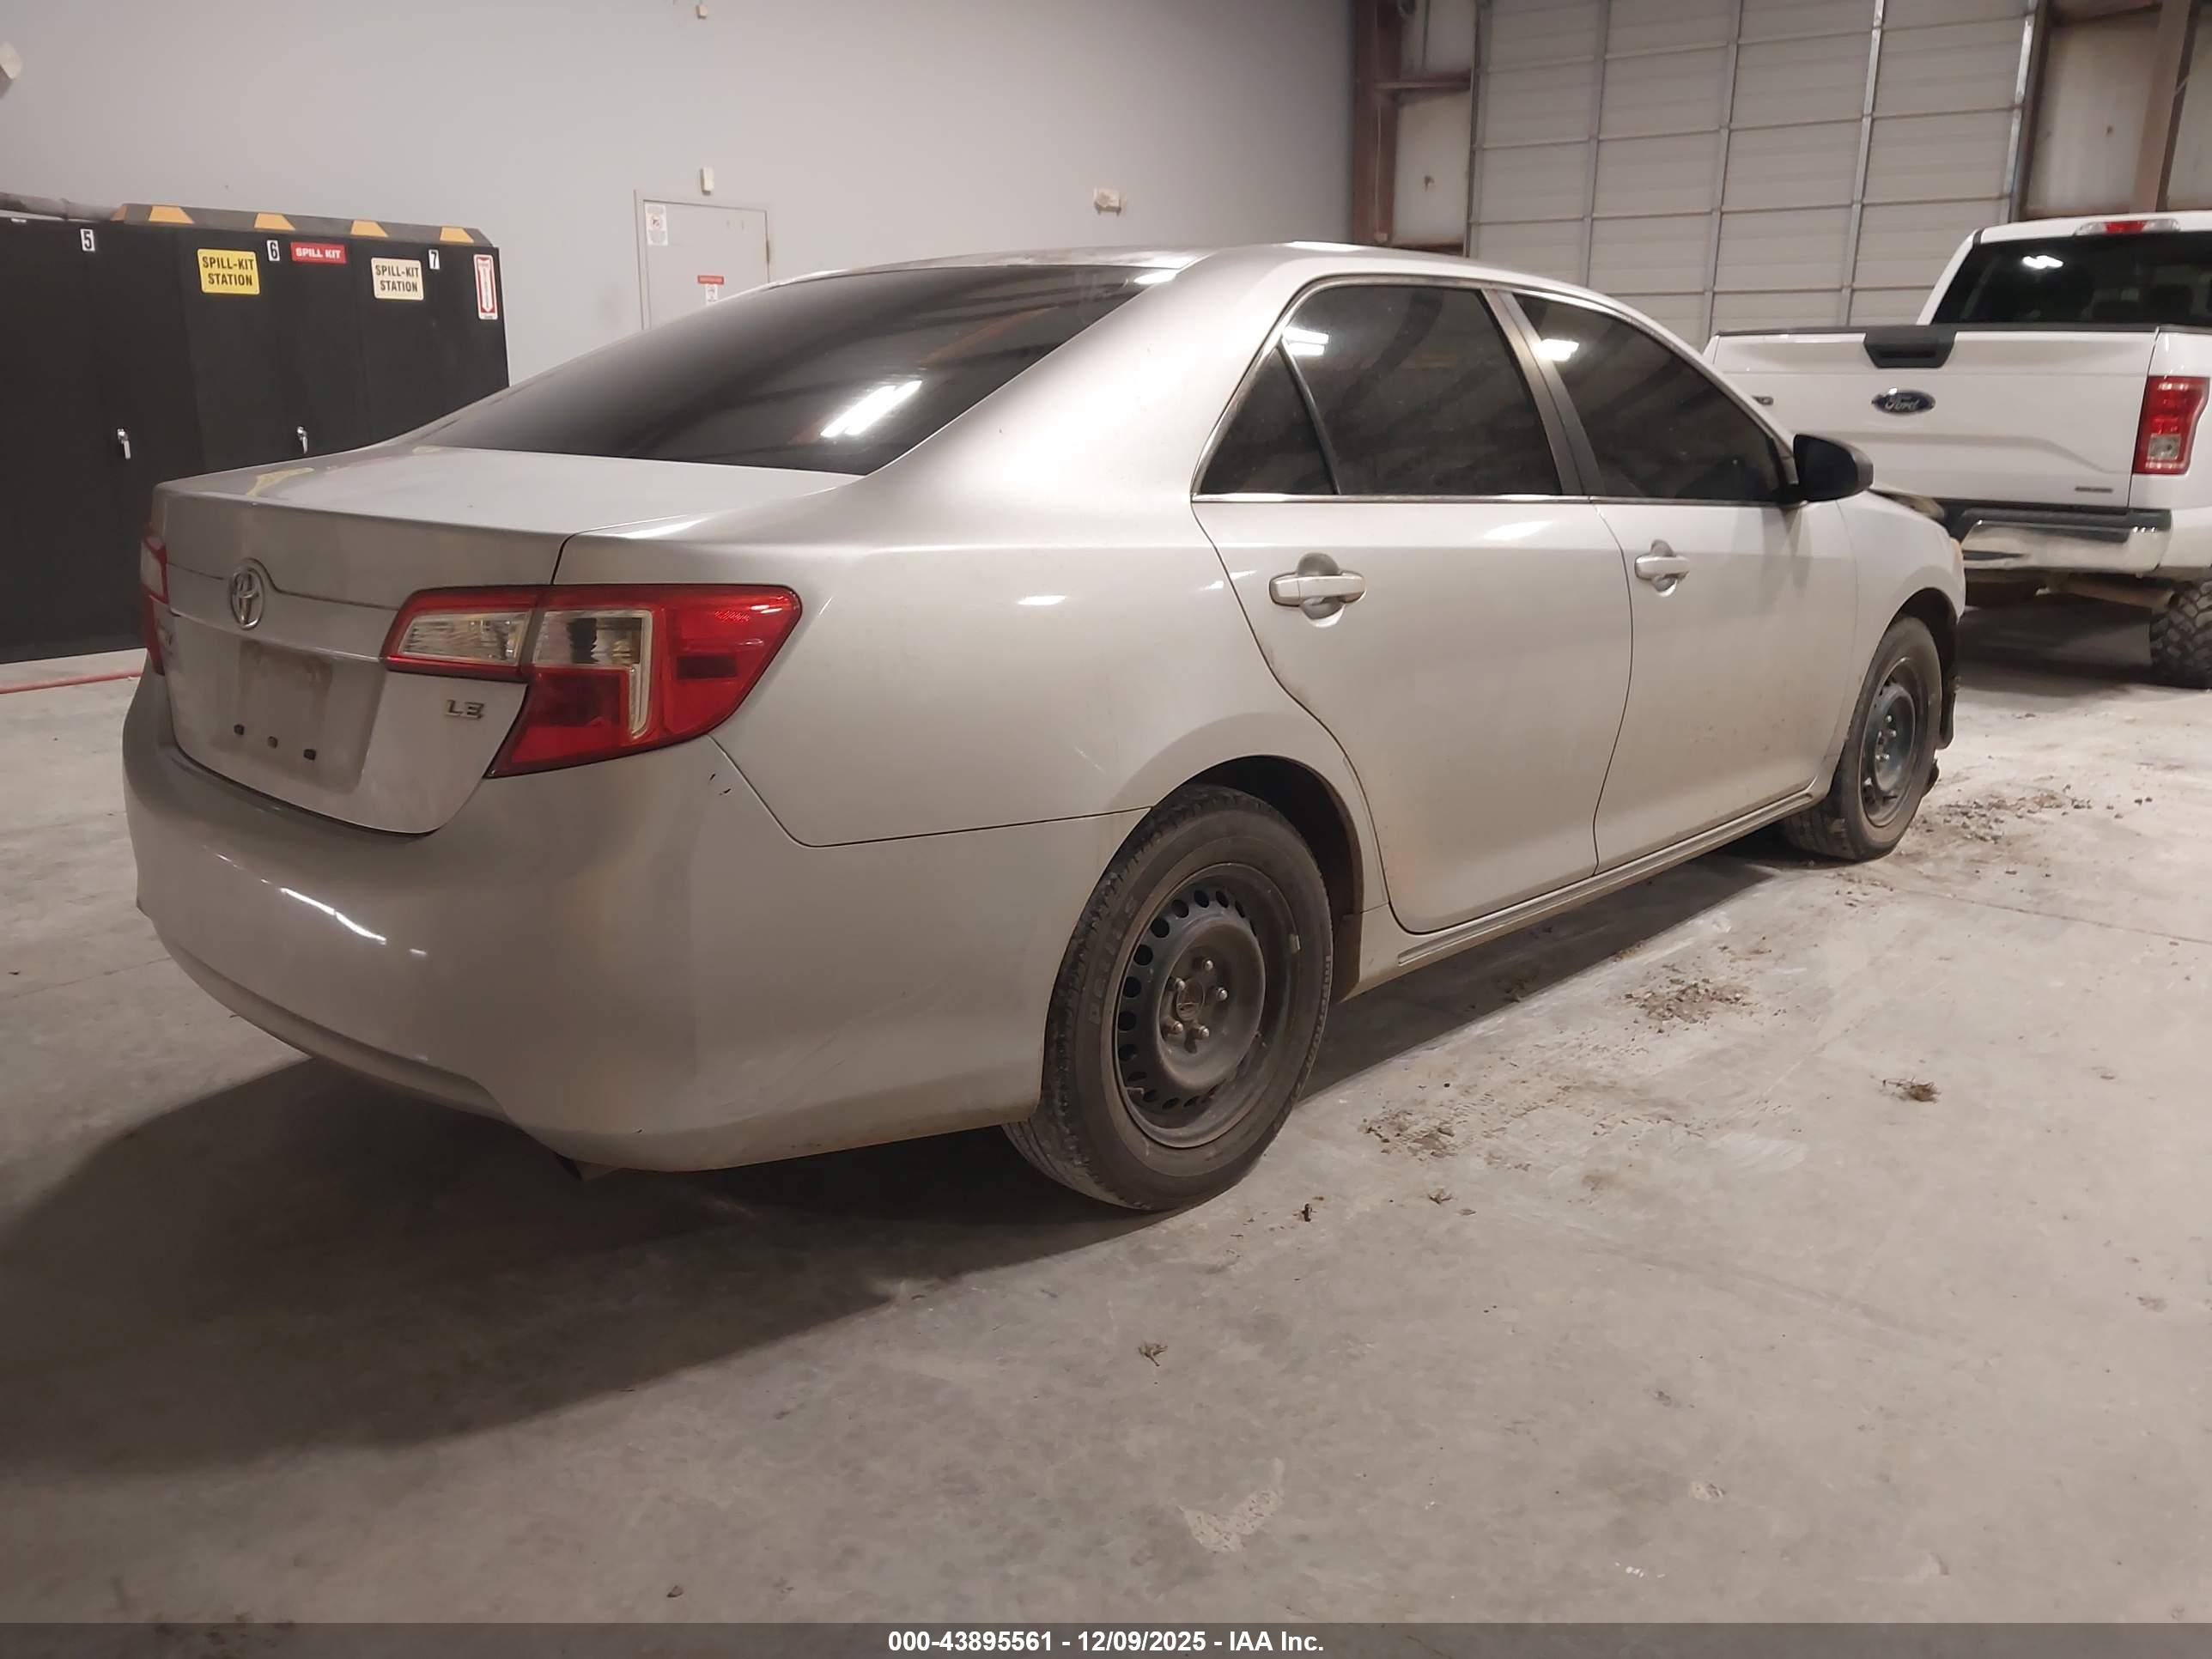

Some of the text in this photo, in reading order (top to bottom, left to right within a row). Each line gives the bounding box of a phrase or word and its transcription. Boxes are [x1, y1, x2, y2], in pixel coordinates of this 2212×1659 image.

[83, 229, 93, 249] 5
[270, 241, 278, 259] 6
[295, 247, 342, 259] SPILL KIT
[202, 256, 254, 270] SPILL-KIT
[430, 251, 437, 269] 7
[375, 264, 419, 277] SPILL-KIT
[208, 272, 252, 286] STATION
[380, 280, 418, 292] STATION
[445, 699, 485, 720] LE
